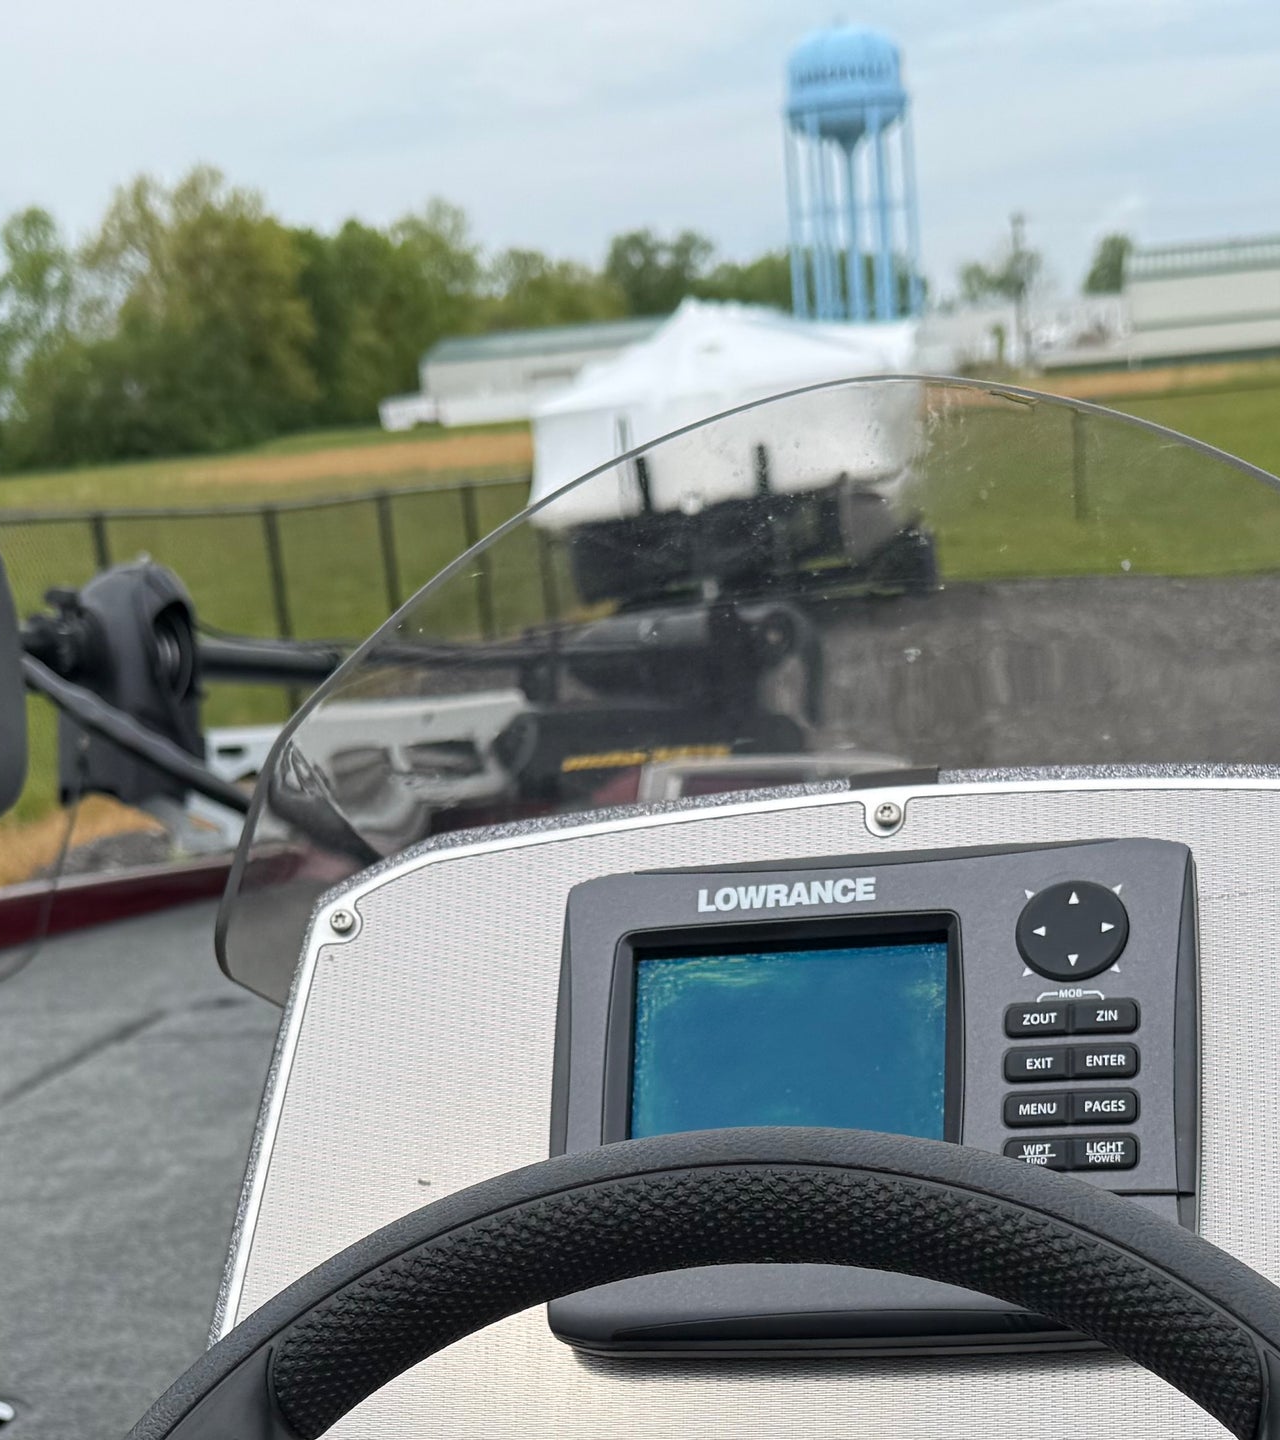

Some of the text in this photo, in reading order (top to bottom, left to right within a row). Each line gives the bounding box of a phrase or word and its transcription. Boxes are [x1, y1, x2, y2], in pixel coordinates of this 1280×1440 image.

[698, 876, 877, 913] LOWRANCE
[1059, 989, 1083, 998] MOB
[1022, 1012, 1058, 1026] ZOUT
[1096, 1010, 1119, 1022] ZIN
[1026, 1057, 1054, 1070] EXIT
[1085, 1054, 1126, 1067] ENTER
[1018, 1102, 1057, 1116] MENU
[1084, 1100, 1126, 1113] PAGES
[1023, 1143, 1052, 1156] WPT
[1086, 1141, 1125, 1154] LIGHT
[1088, 1154, 1122, 1163] POWER
